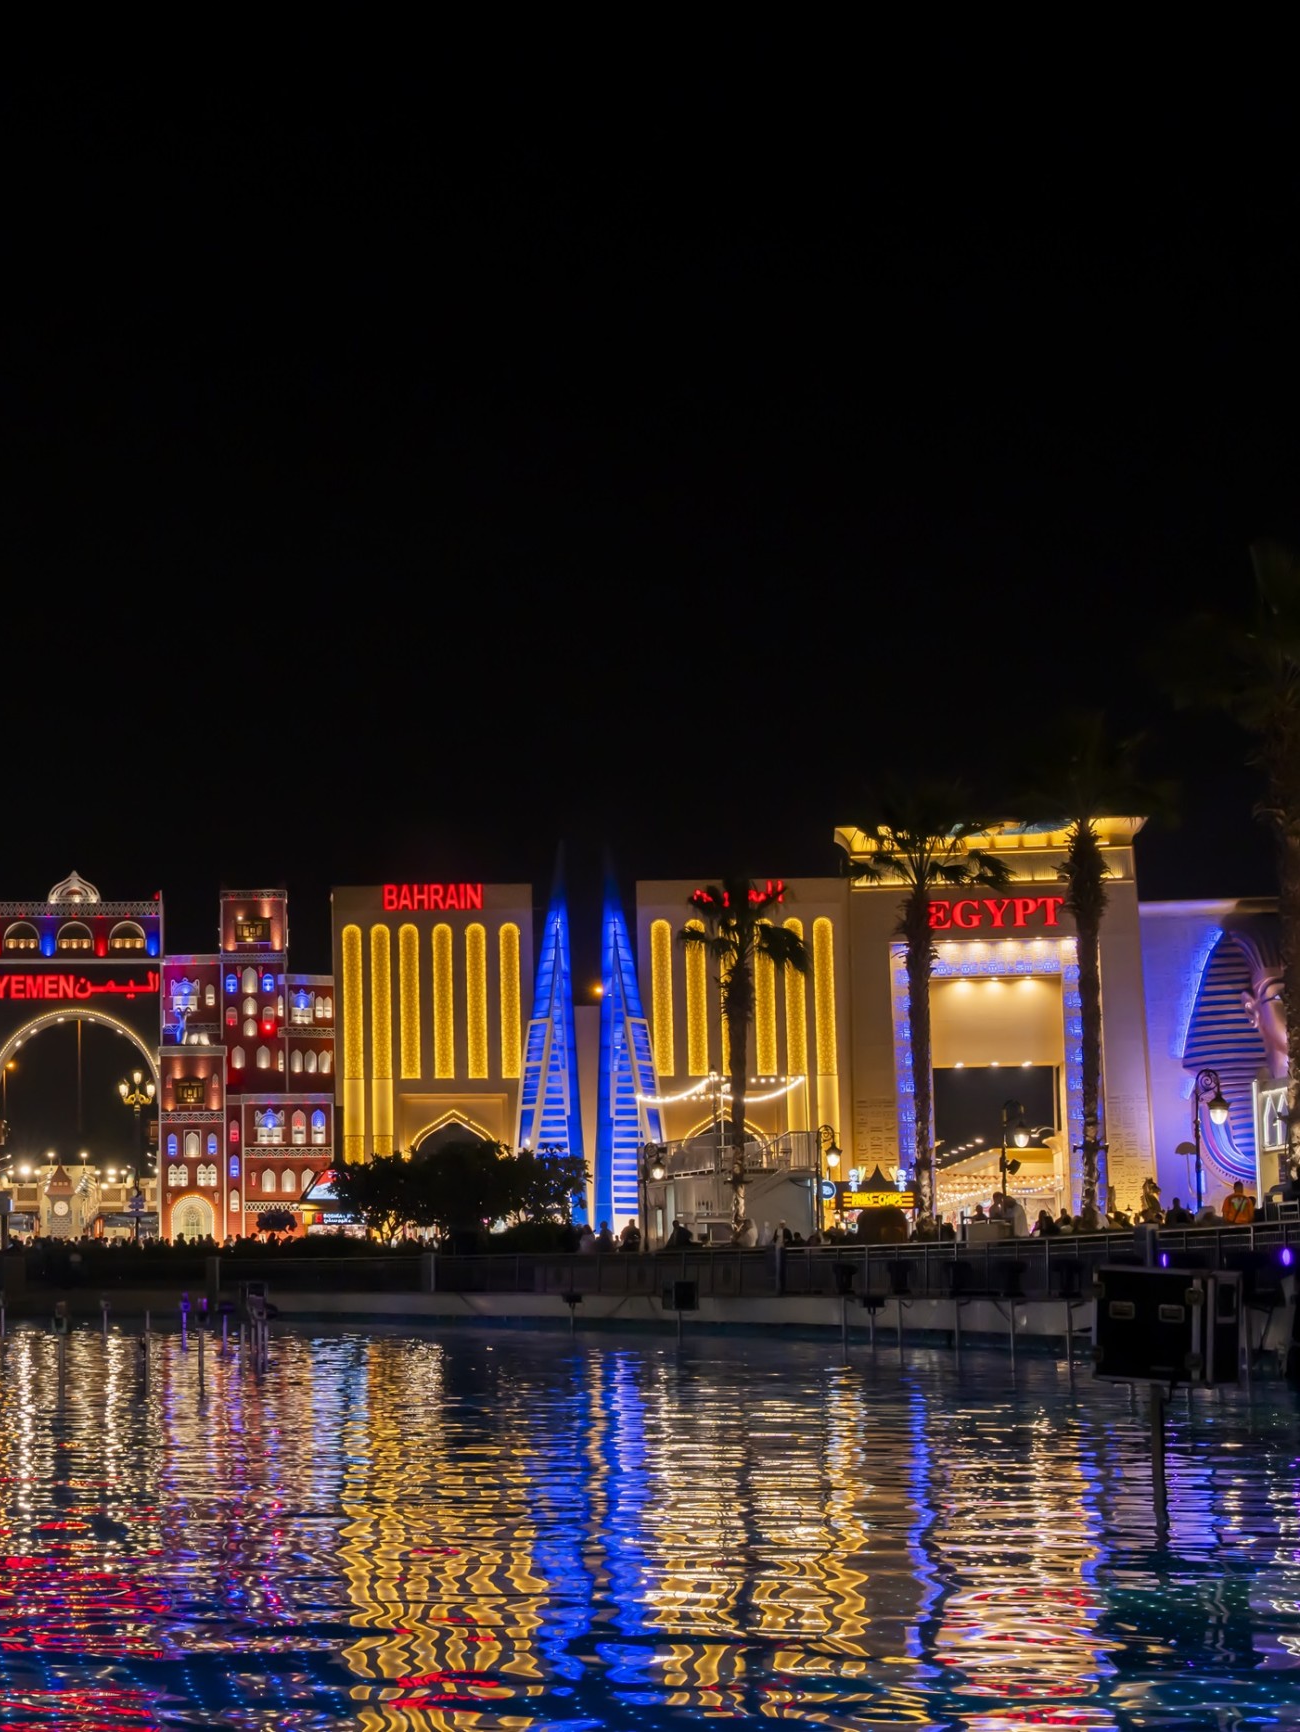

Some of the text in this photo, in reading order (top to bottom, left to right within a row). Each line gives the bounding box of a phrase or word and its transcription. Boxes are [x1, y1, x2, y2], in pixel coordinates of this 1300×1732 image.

[383, 883, 482, 911] BAHRAIN
[927, 896, 1065, 929] EGYPT
[74, 970, 160, 999] اليمن
